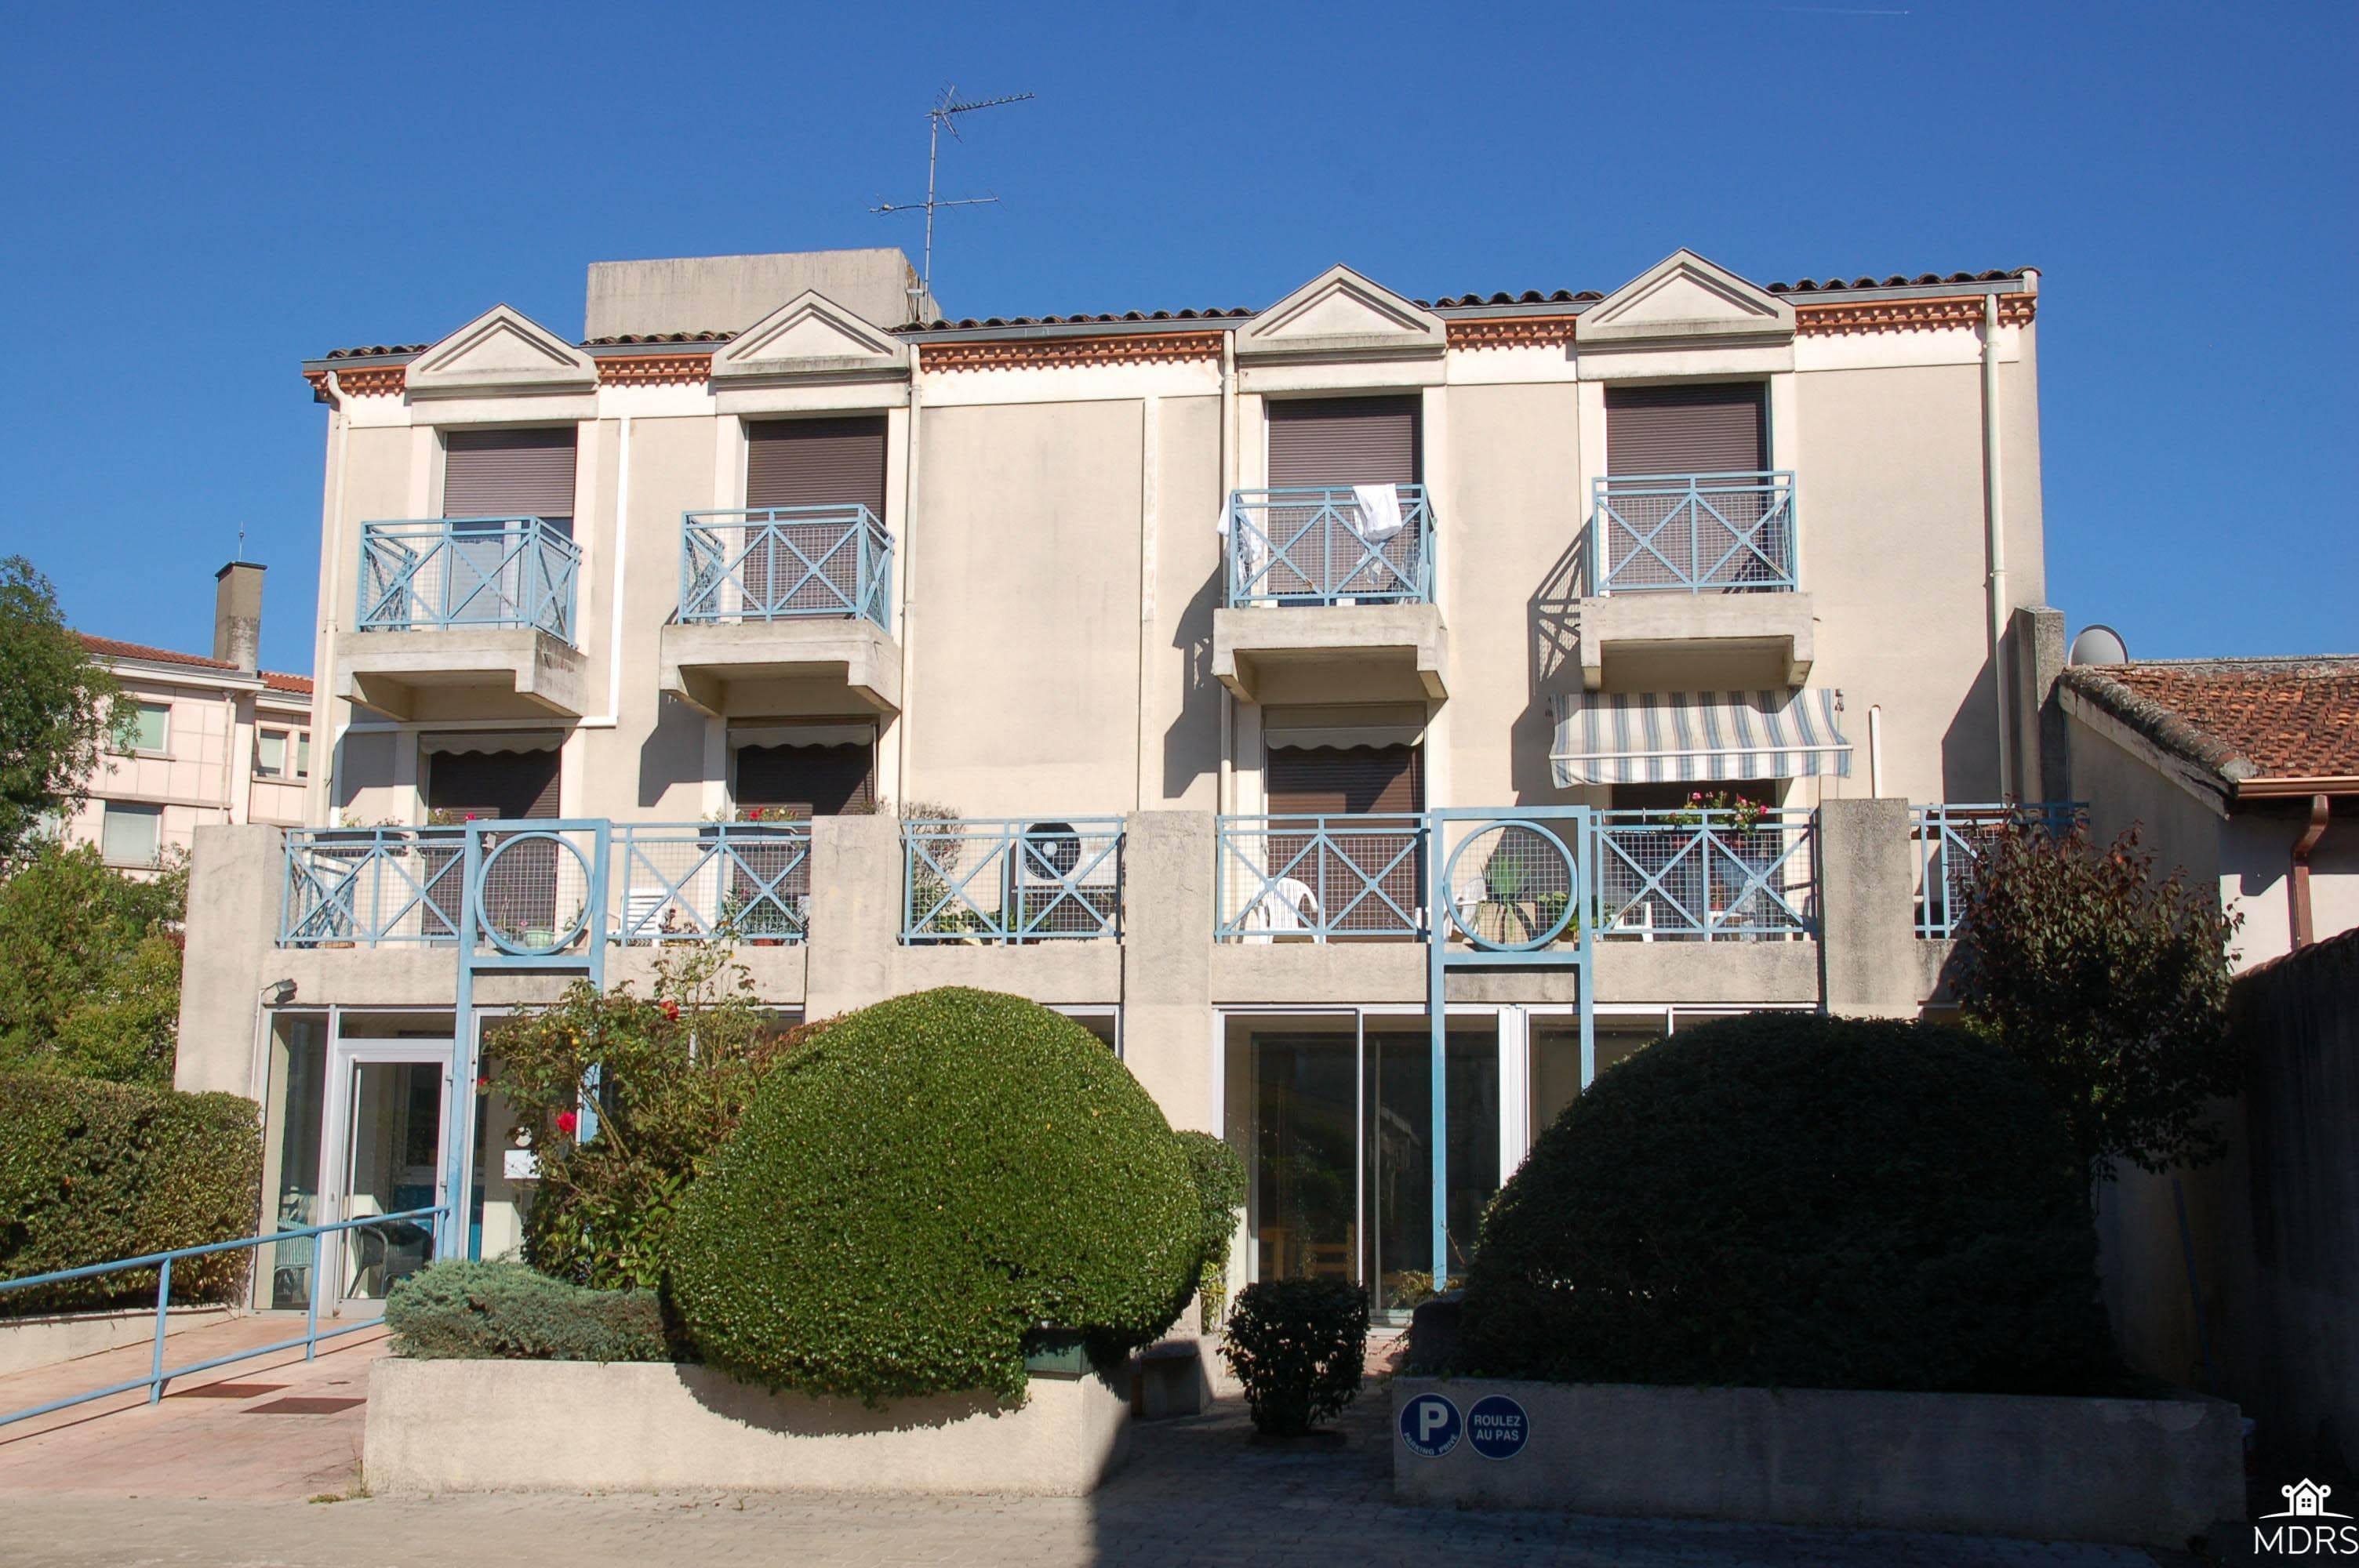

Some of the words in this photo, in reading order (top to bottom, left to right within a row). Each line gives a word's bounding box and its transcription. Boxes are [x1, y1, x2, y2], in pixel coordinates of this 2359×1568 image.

[1419, 1401, 1448, 1442] P
[1474, 1414, 1521, 1427] ROULEZ
[1404, 1432, 1435, 1456] PARKING
[1476, 1429, 1492, 1441] AU
[1496, 1429, 1520, 1441] PAS
